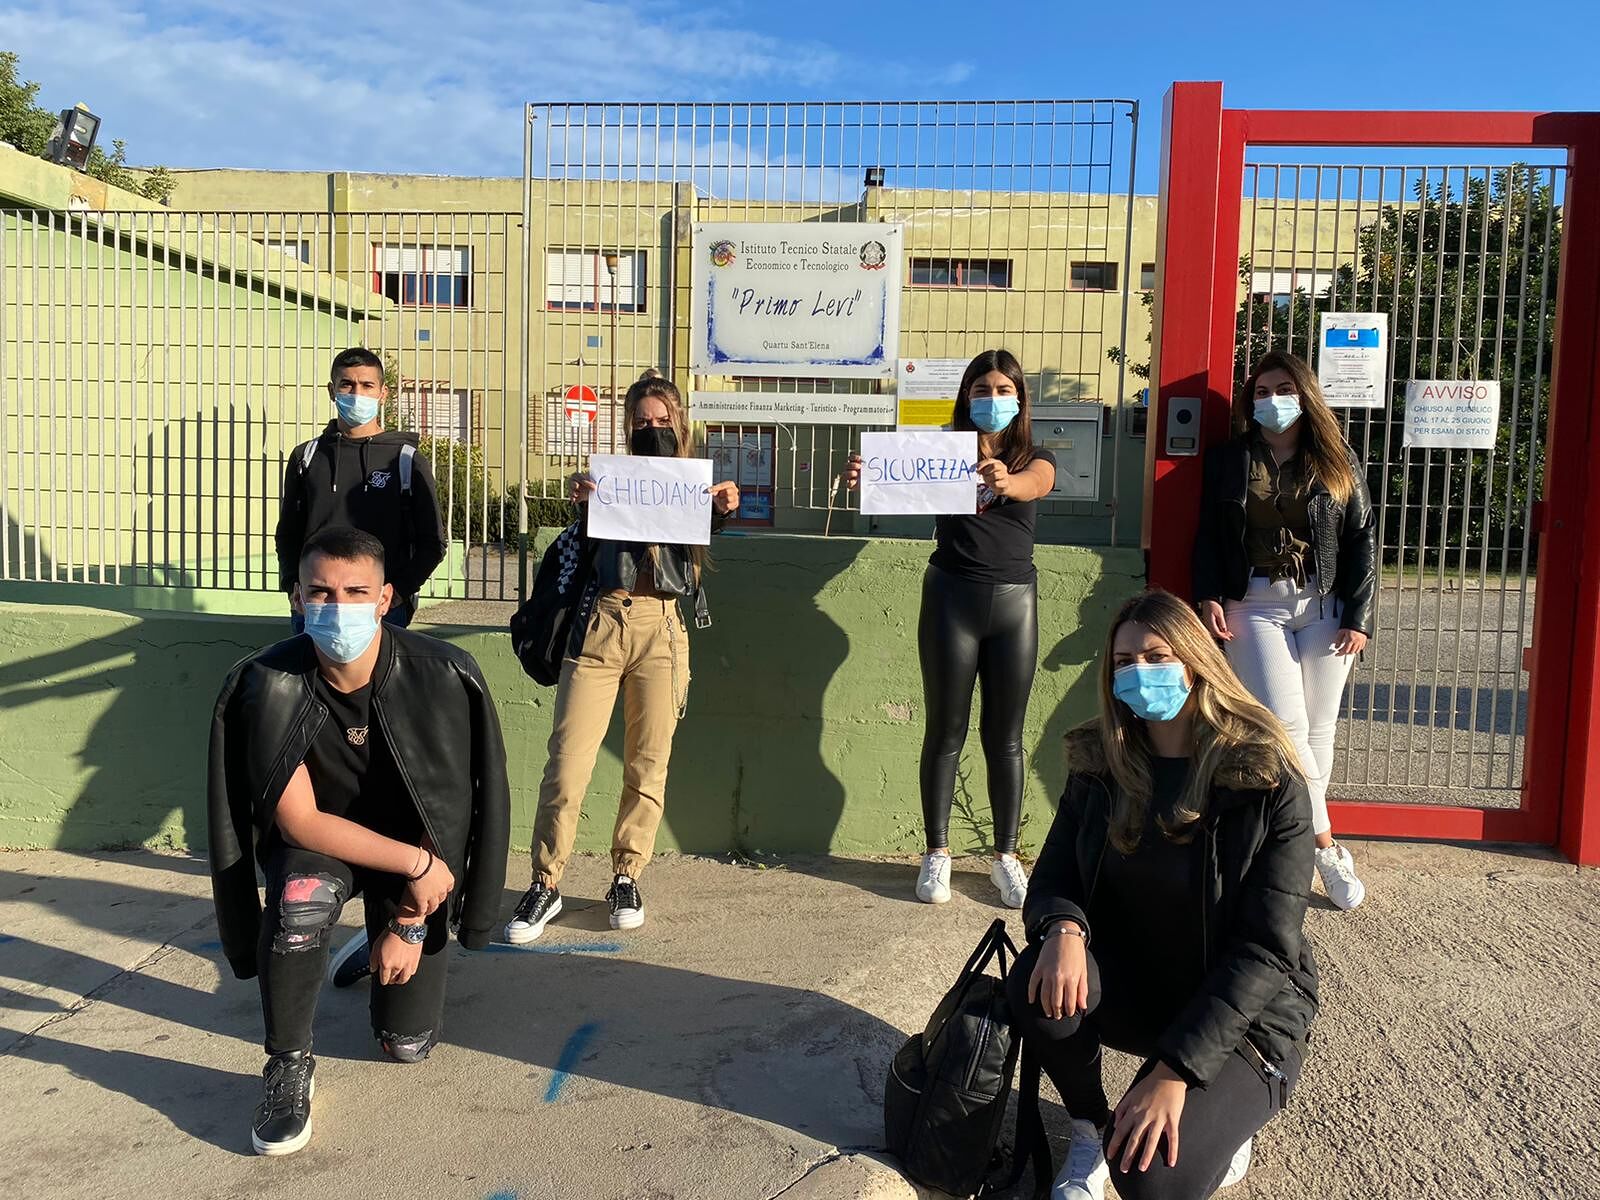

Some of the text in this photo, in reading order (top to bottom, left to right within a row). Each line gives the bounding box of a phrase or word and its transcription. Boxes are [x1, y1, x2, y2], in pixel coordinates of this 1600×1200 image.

[741, 240, 858, 255] Istituto Tecnico Statale
[746, 258, 849, 273] Economico e Tecnologico
[731, 287, 862, 317] "Primo Levi"
[762, 341, 830, 350] Quartu Sant'Elena
[1422, 385, 1488, 400] AVVISO
[699, 401, 748, 411] Amministrazione
[749, 402, 772, 411] Finanza
[774, 402, 804, 415] Marketing
[811, 403, 837, 413] Turistico
[1413, 416, 1428, 424] DAL
[867, 456, 972, 482] SICUREZZA
[596, 475, 710, 510] CHIEDIAMO
